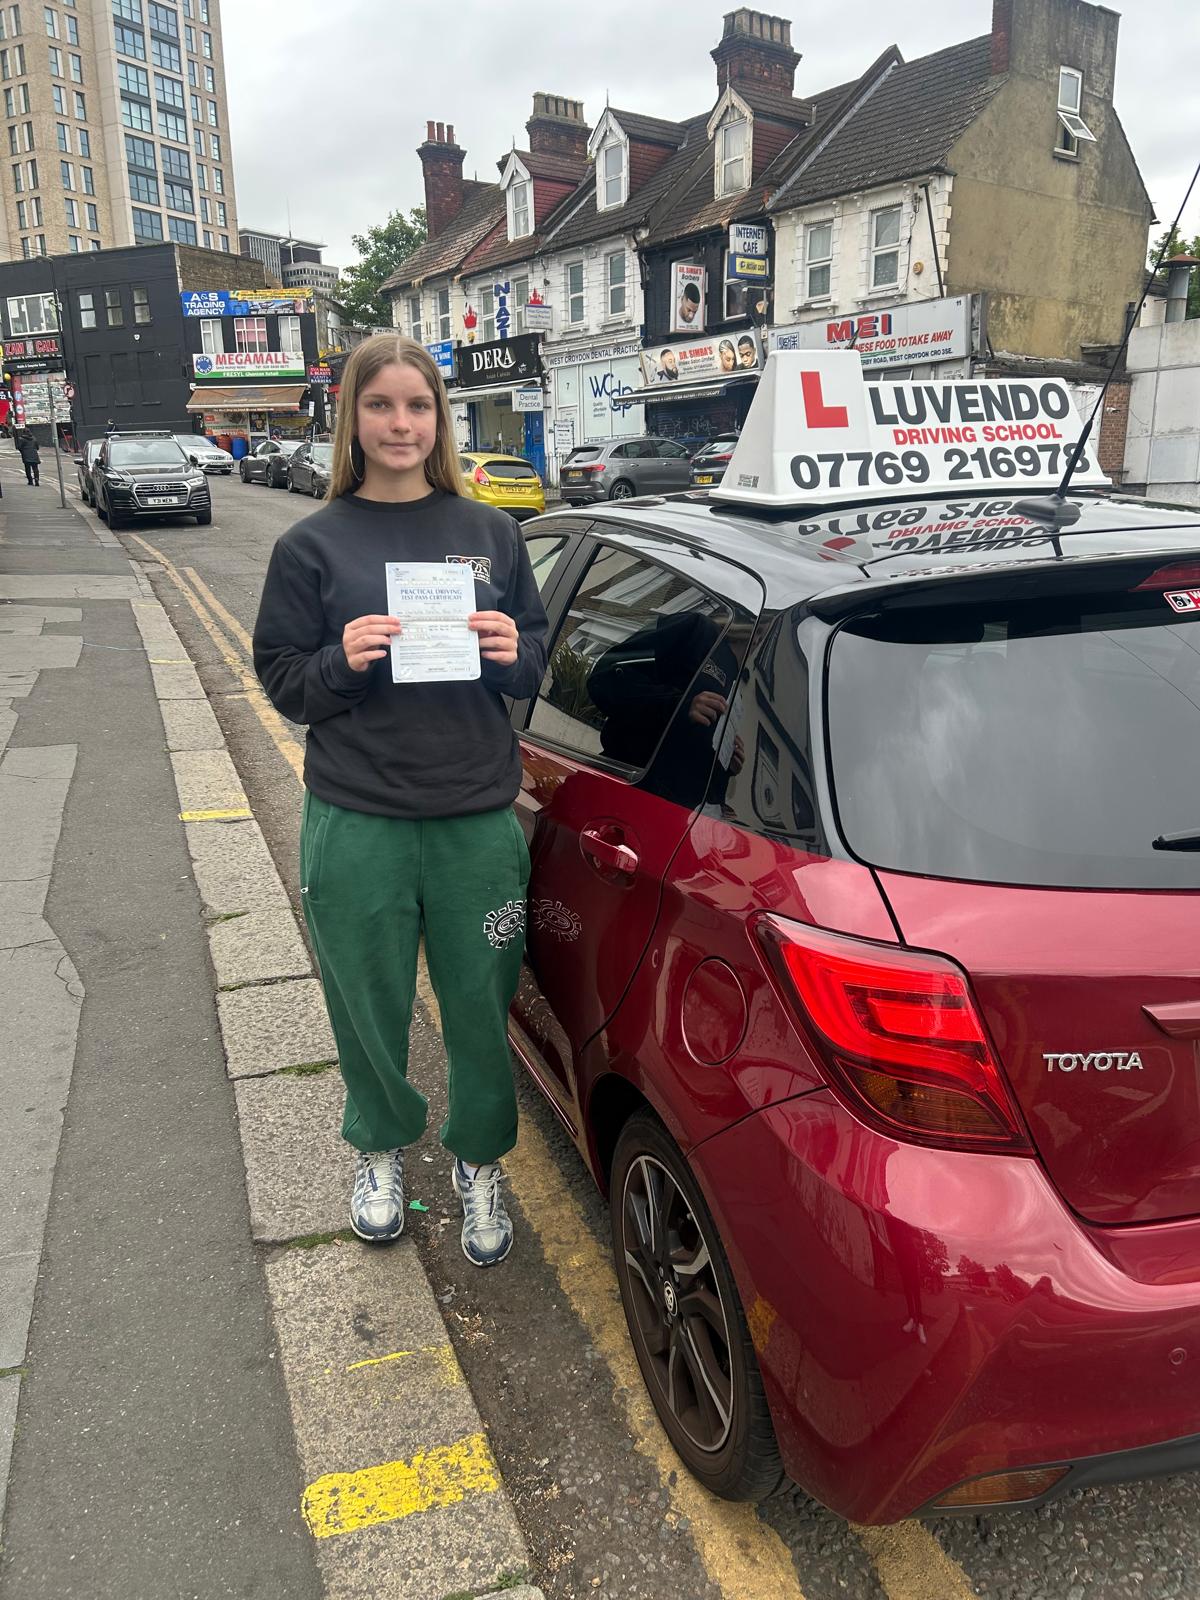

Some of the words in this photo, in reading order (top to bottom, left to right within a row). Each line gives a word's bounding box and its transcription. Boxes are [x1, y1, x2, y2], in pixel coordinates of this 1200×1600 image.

[736, 226, 765, 241] INTERNET
[743, 240, 758, 254] CAFÉ
[184, 301, 226, 309] TRADING
[187, 308, 225, 316] AGENCY
[494, 281, 511, 339] NIAZI
[827, 314, 893, 343] MEI
[35, 340, 58, 353] CALL
[874, 338, 897, 351] FOOD
[930, 329, 954, 344] AWAY
[215, 352, 290, 366] MEGAMALL
[472, 347, 516, 372] DERA
[565, 352, 590, 364] CROYDON
[591, 348, 612, 360] DENTAL
[613, 344, 640, 356] PRACTIC
[689, 345, 713, 359] SIMBA'S
[889, 354, 904, 363] WEST
[904, 351, 930, 361] CROYDON
[518, 401, 541, 409] Practice
[800, 371, 849, 428] L
[868, 382, 1070, 426] LUVENDO
[892, 427, 977, 447] DRIVING
[982, 423, 1063, 443] SCHOOL
[790, 450, 930, 490] 07769
[943, 442, 1091, 481] 216978
[1042, 1051, 1144, 1073] TOYOTA
